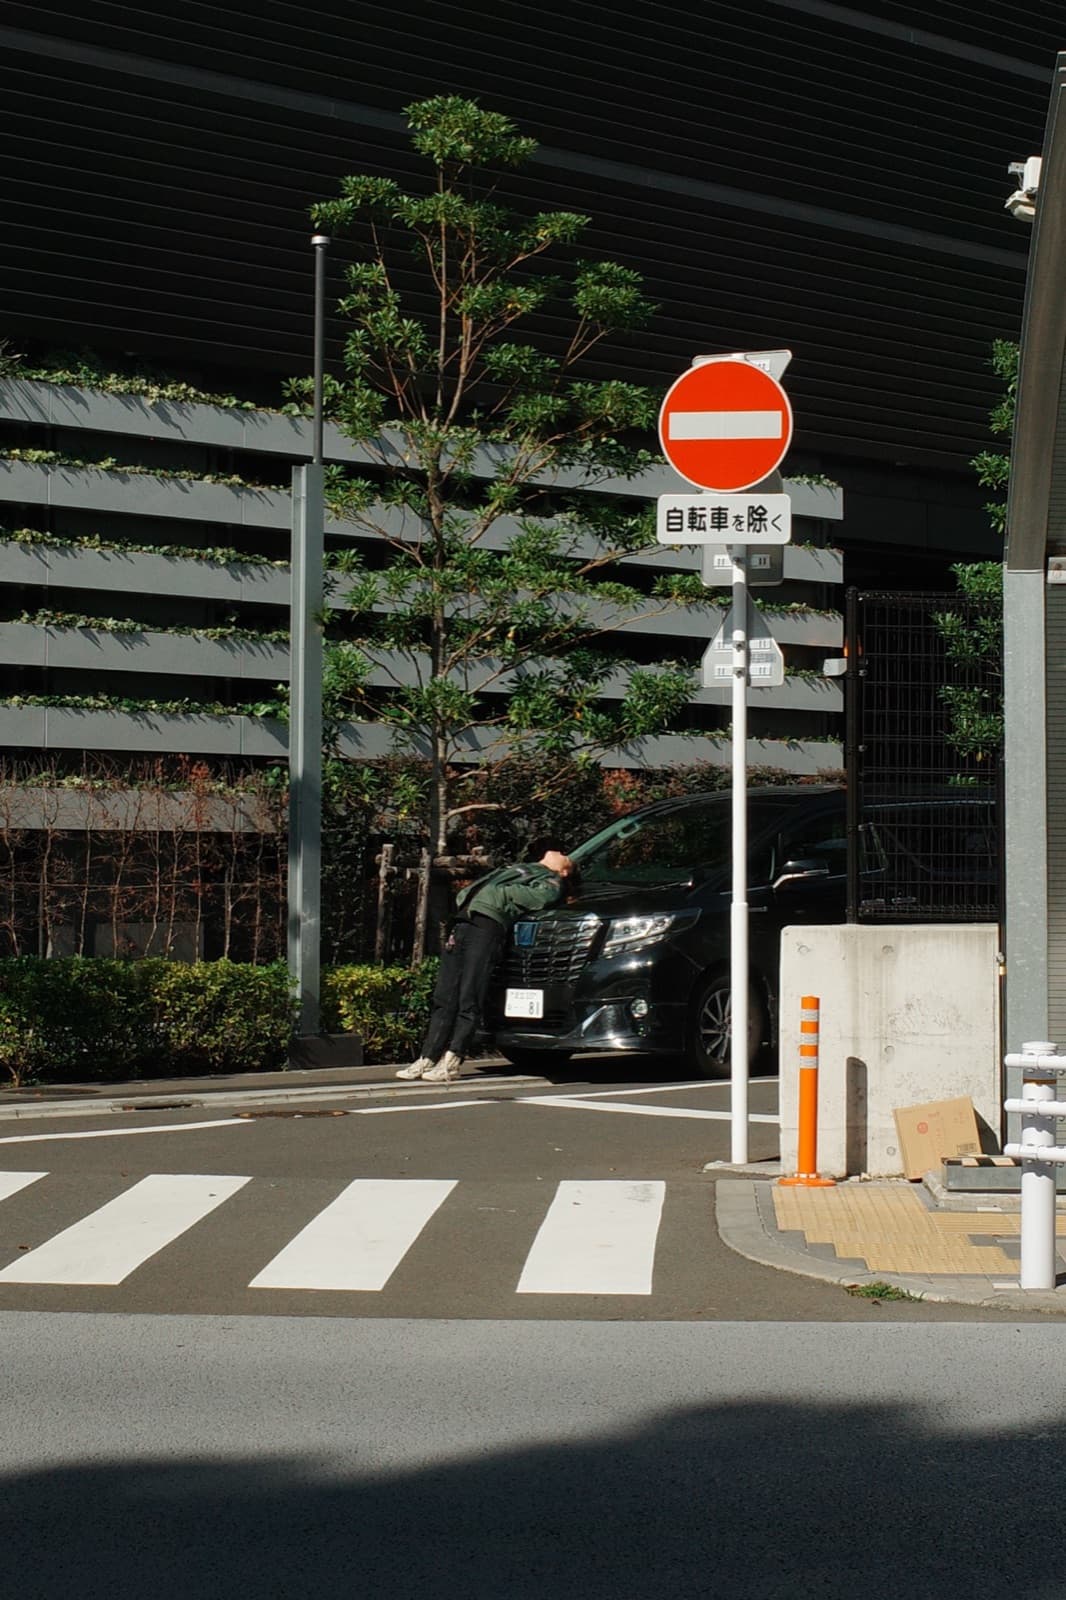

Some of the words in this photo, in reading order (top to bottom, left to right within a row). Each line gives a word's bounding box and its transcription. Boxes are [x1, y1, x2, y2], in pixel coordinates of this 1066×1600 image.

[666, 505, 782, 533] 自転車を除く
